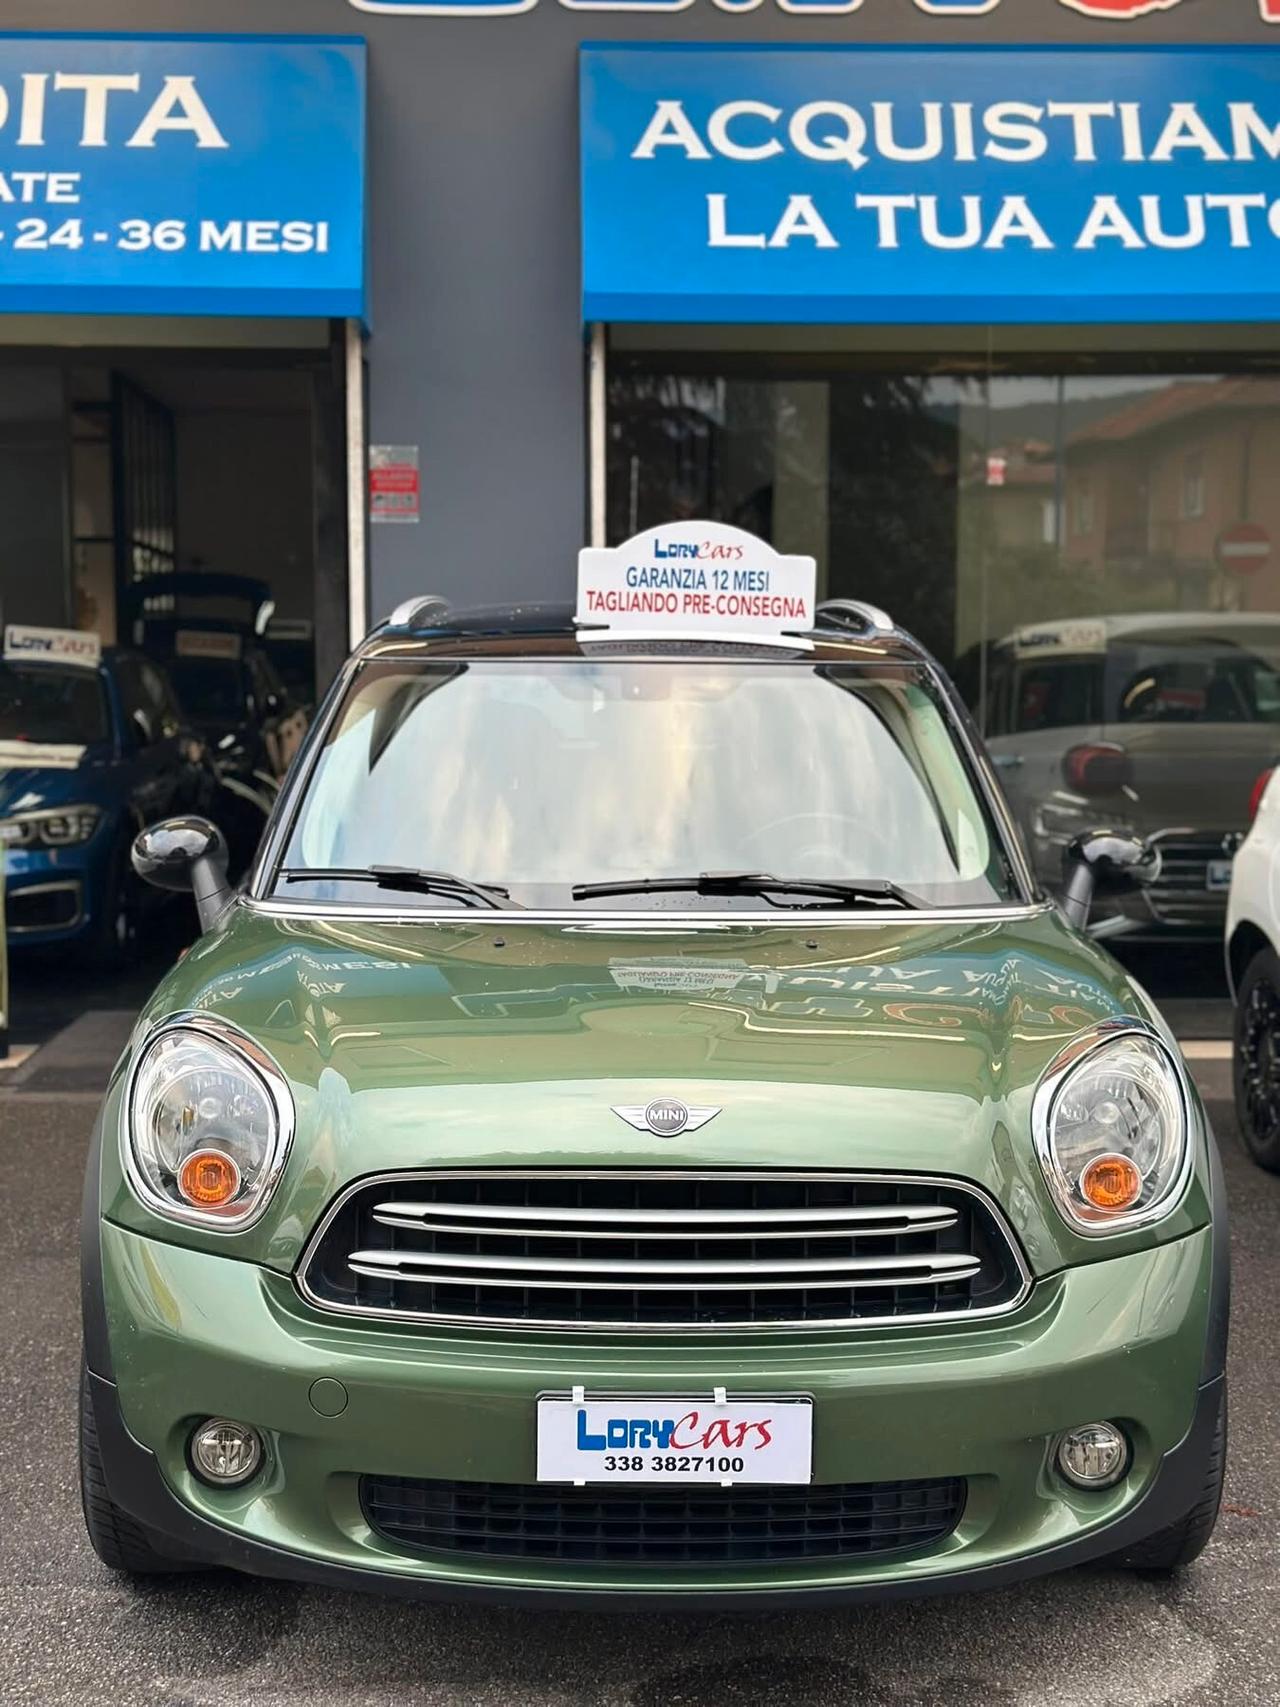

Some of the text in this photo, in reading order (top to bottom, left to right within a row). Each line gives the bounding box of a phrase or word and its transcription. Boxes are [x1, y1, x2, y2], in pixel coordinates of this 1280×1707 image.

[0, 72, 229, 149] ITA
[631, 100, 1280, 170] ACQUISTIAM
[13, 217, 84, 250] 24
[117, 219, 187, 251] 36
[200, 221, 329, 252] MESI
[706, 193, 1280, 249] LA TUA AUT
[626, 566, 771, 593] GARANZIA 12 MESI
[586, 590, 807, 618] TAGLIANDO PRE-CONSEGNA
[649, 1109, 685, 1121] MINI
[604, 1456, 745, 1473] 338 3827100
